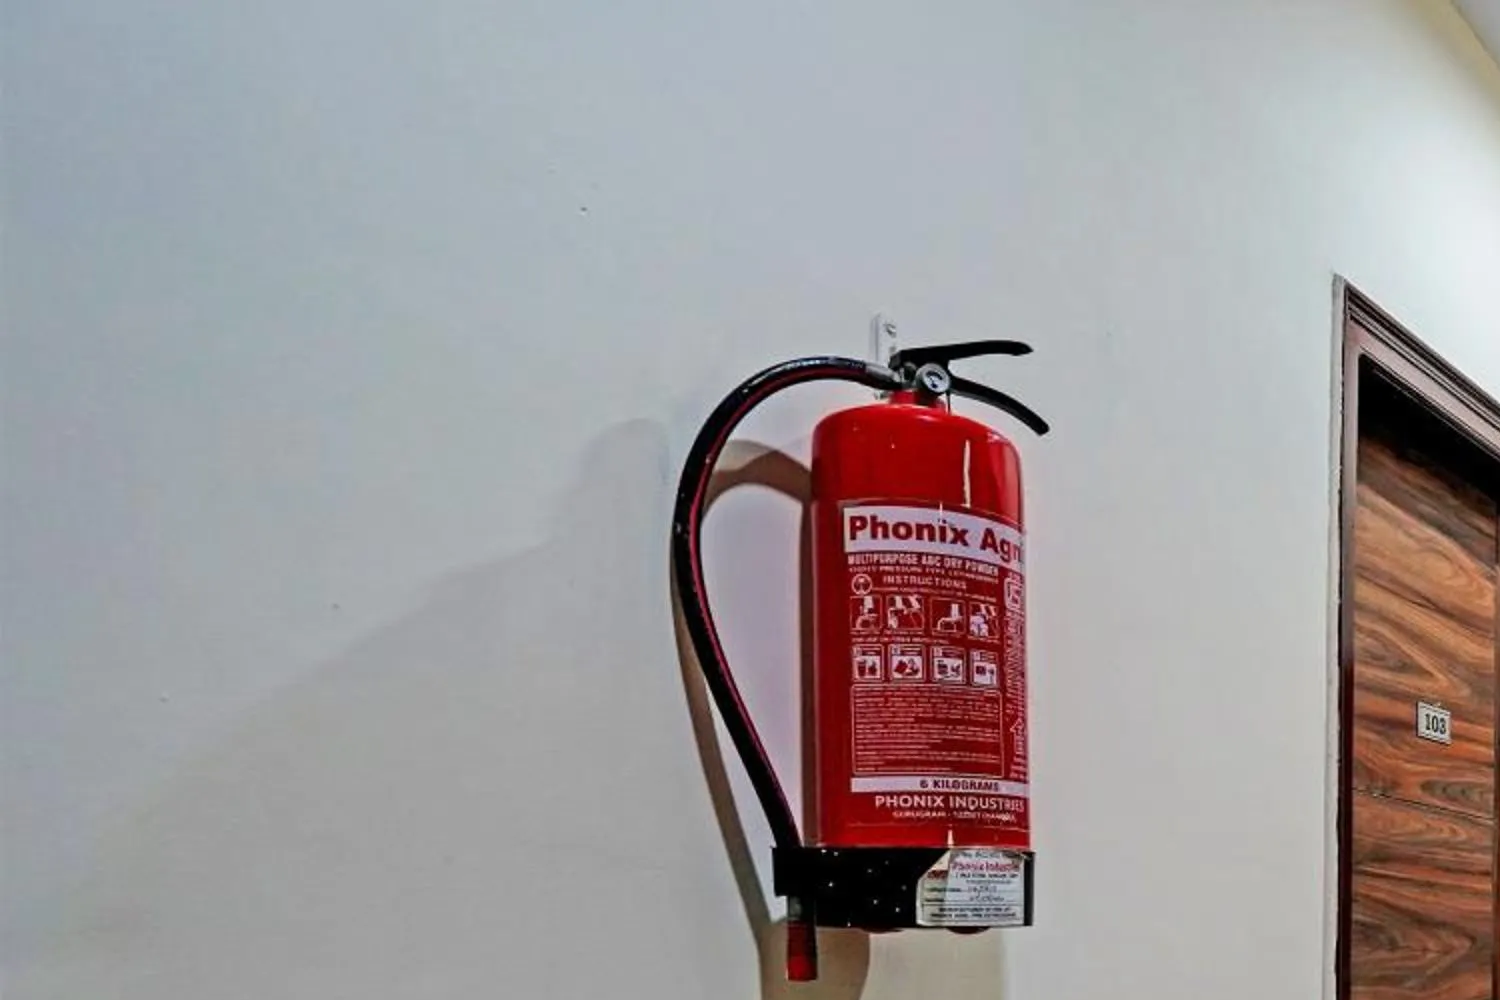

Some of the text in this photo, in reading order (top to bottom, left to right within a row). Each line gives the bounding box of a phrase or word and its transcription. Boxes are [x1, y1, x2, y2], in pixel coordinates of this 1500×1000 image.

[849, 515, 1024, 562] Phonix Agn
[944, 557, 963, 568] DRY
[883, 575, 967, 589] INSTRUCTIONS
[1425, 713, 1447, 735] 103
[919, 780, 999, 791] 6 KILOGRAMS
[875, 795, 1025, 811] PHONIX INDUSTRIES
